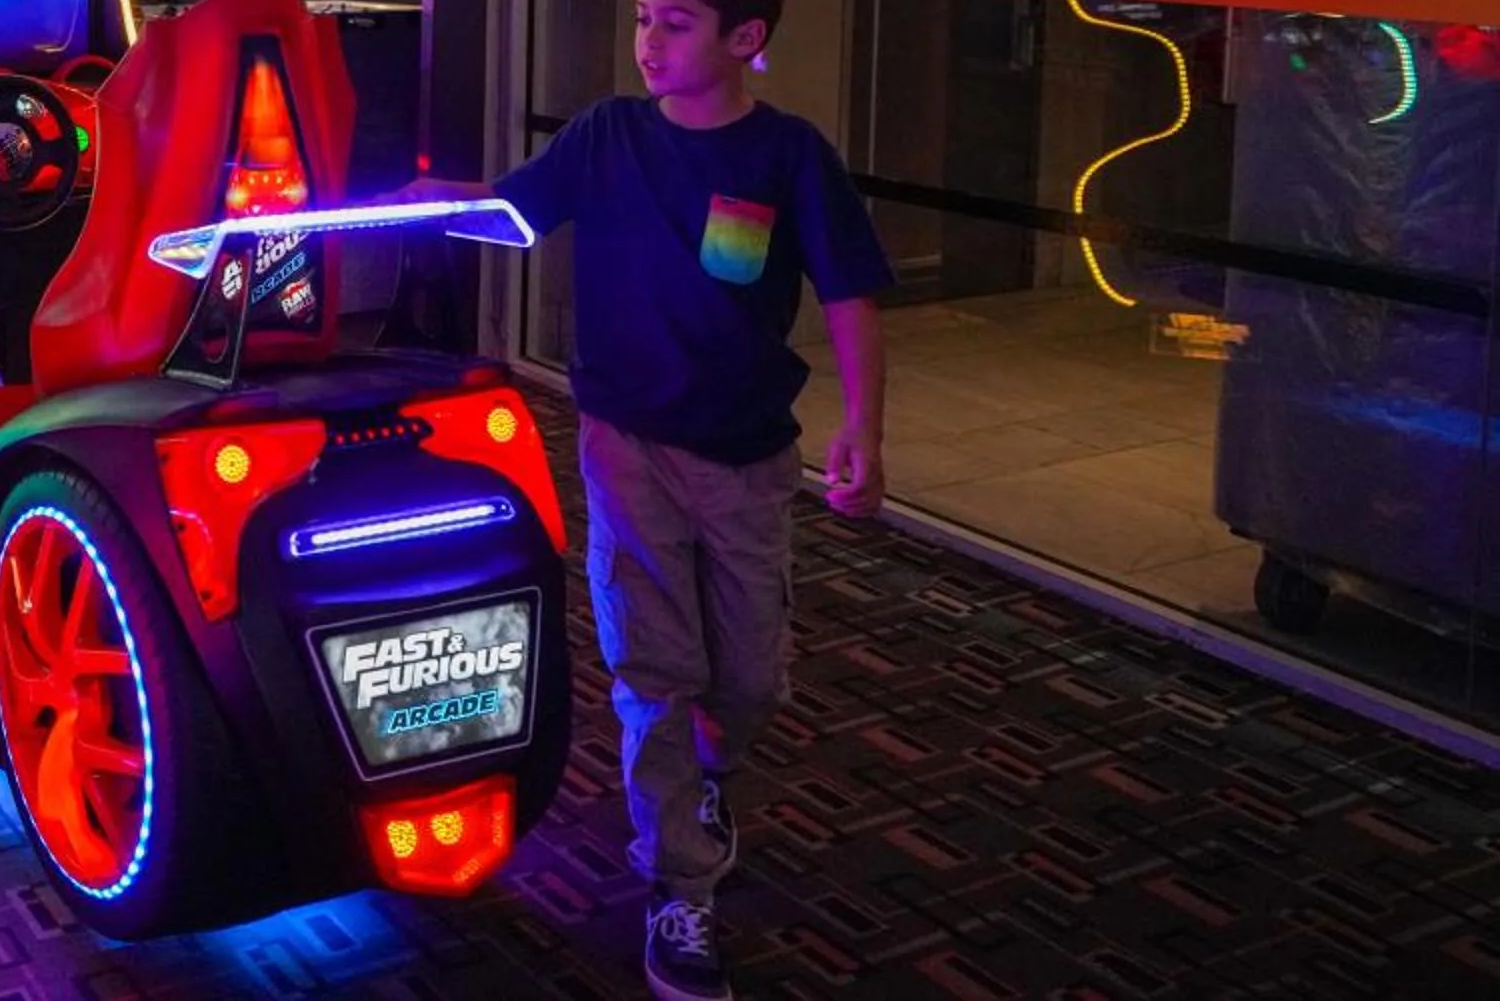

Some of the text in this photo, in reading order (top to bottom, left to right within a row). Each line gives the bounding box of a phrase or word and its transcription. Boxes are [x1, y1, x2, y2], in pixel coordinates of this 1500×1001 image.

[343, 628, 466, 682] FAST &
[357, 642, 524, 709] FURIOUS
[387, 690, 500, 734] ARCADE
